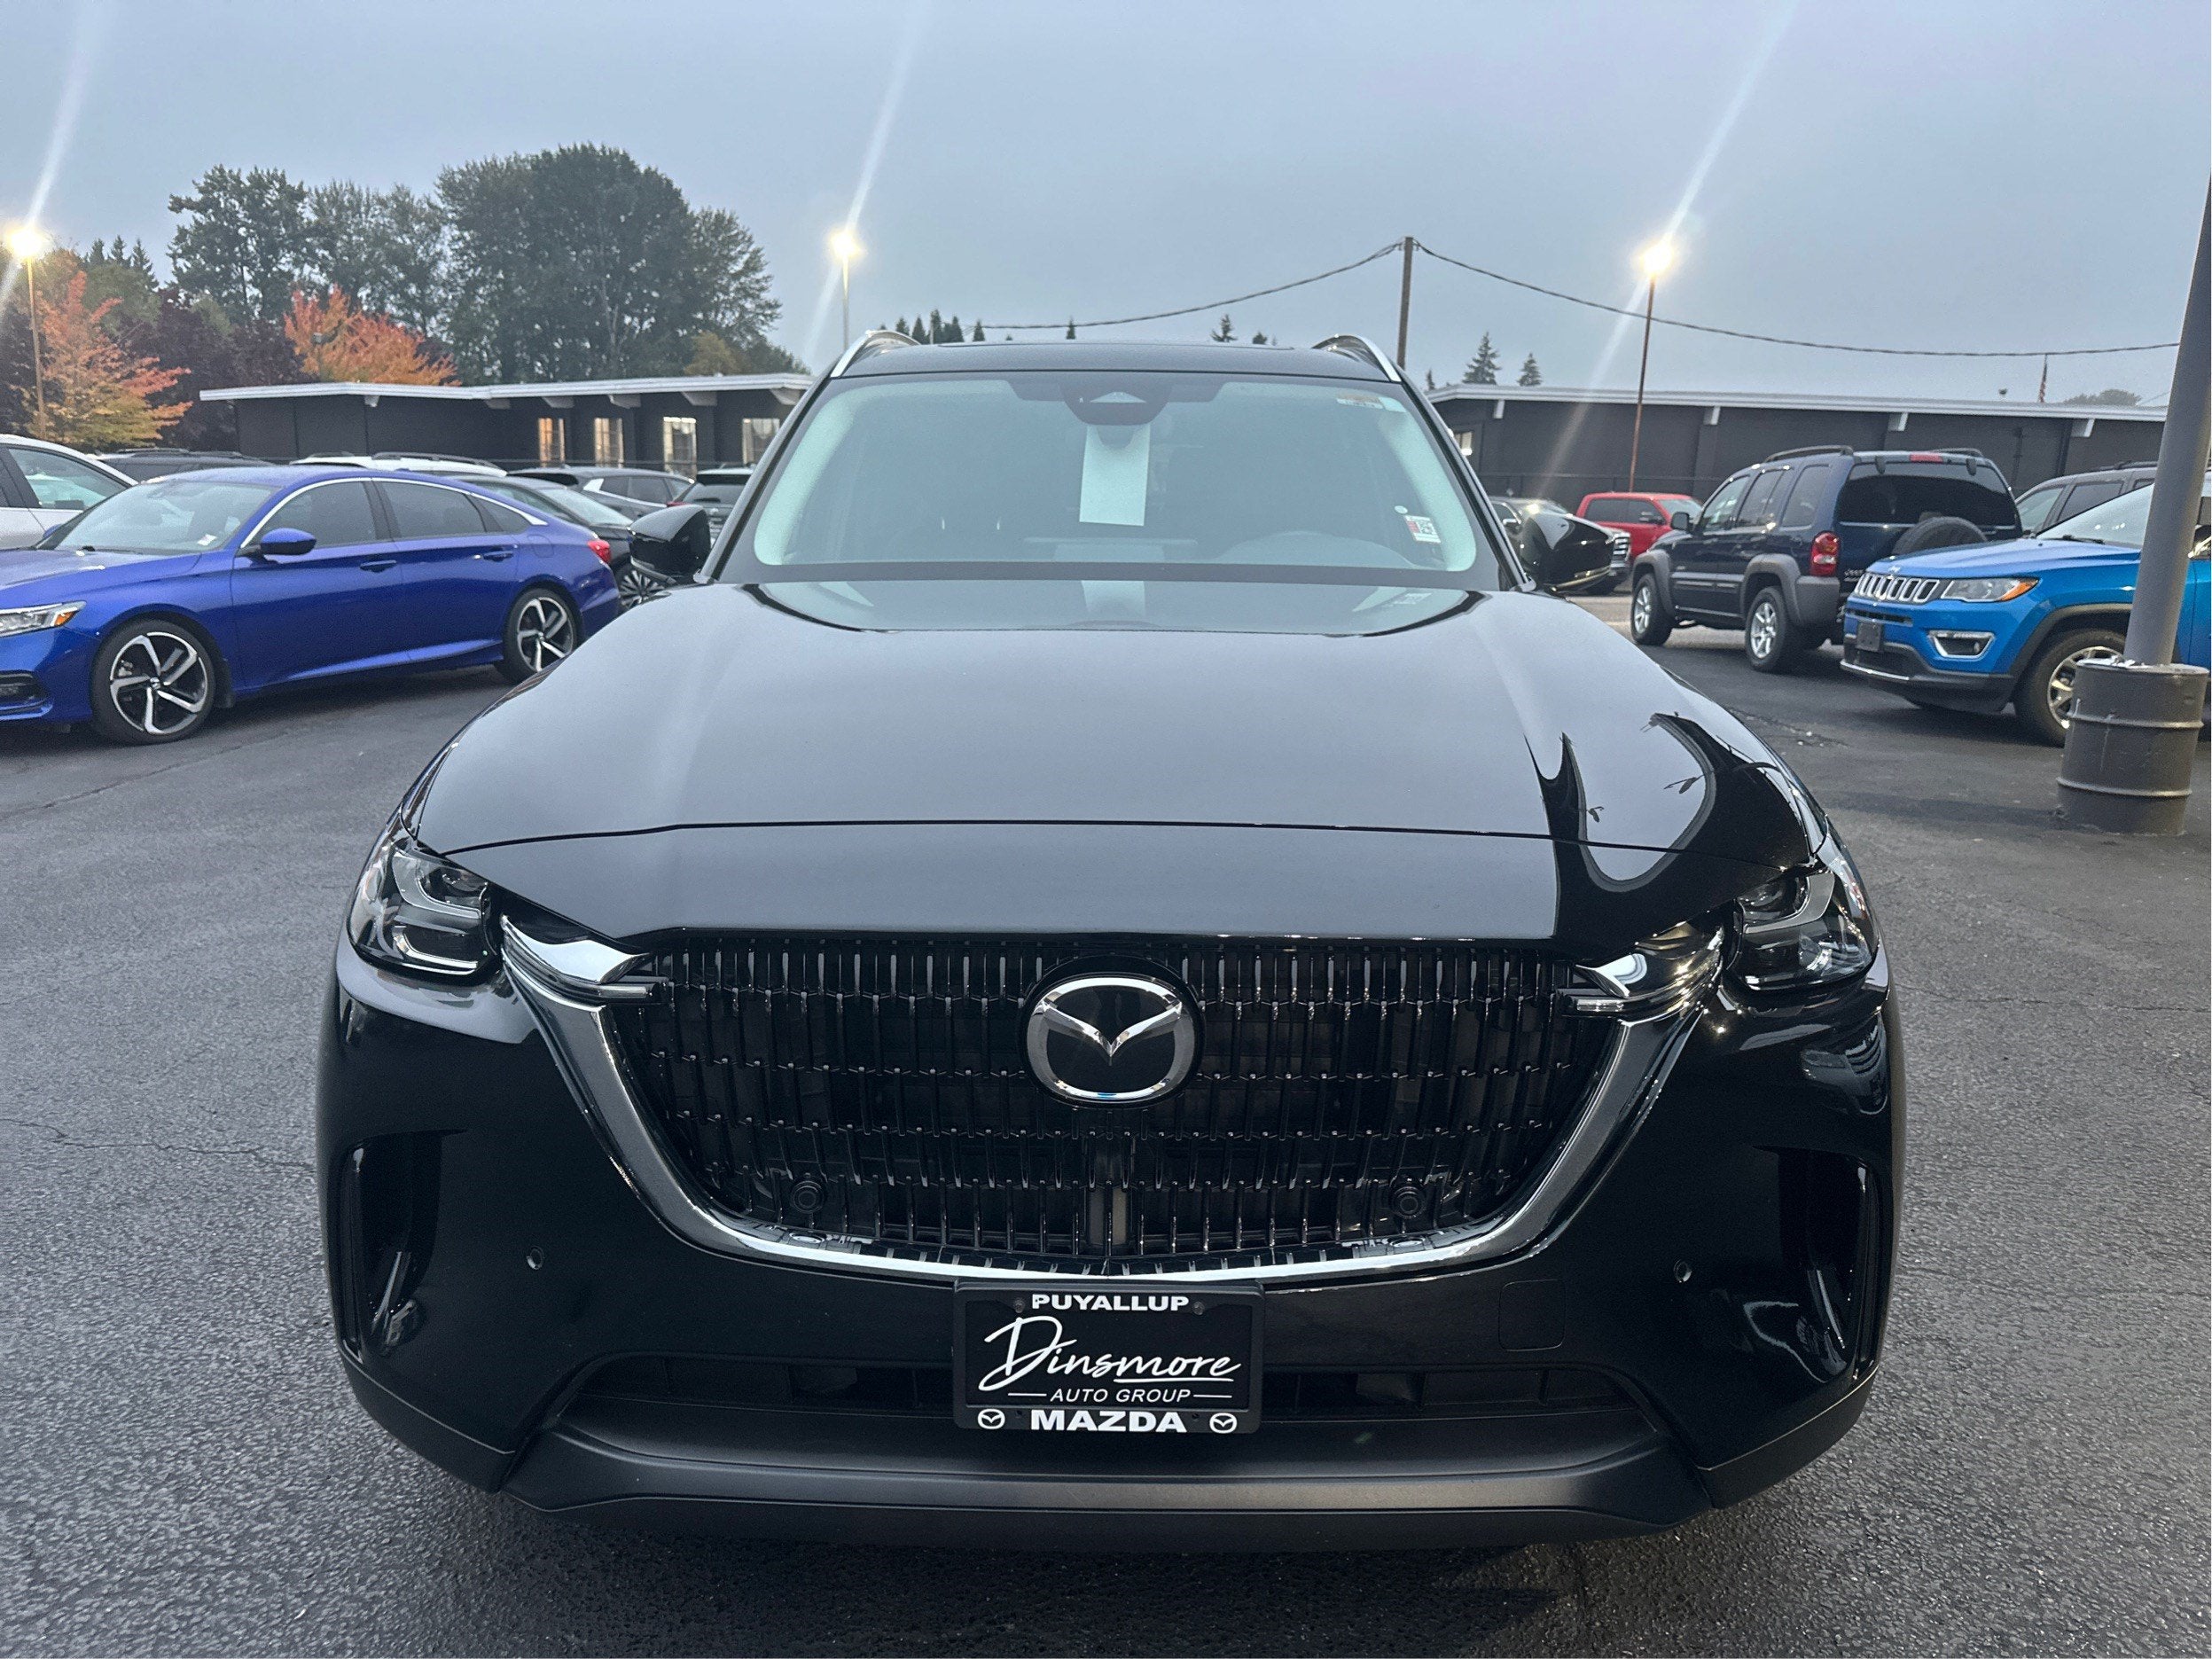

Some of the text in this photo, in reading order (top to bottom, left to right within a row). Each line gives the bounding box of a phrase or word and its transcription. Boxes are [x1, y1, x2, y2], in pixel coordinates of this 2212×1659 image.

[1031, 1294, 1190, 1311] PUYALLUP
[978, 1315, 1241, 1391] Dinsmore
[1050, 1388, 1191, 1403] AUTO GROUP
[1030, 1409, 1187, 1433] MAZDA
